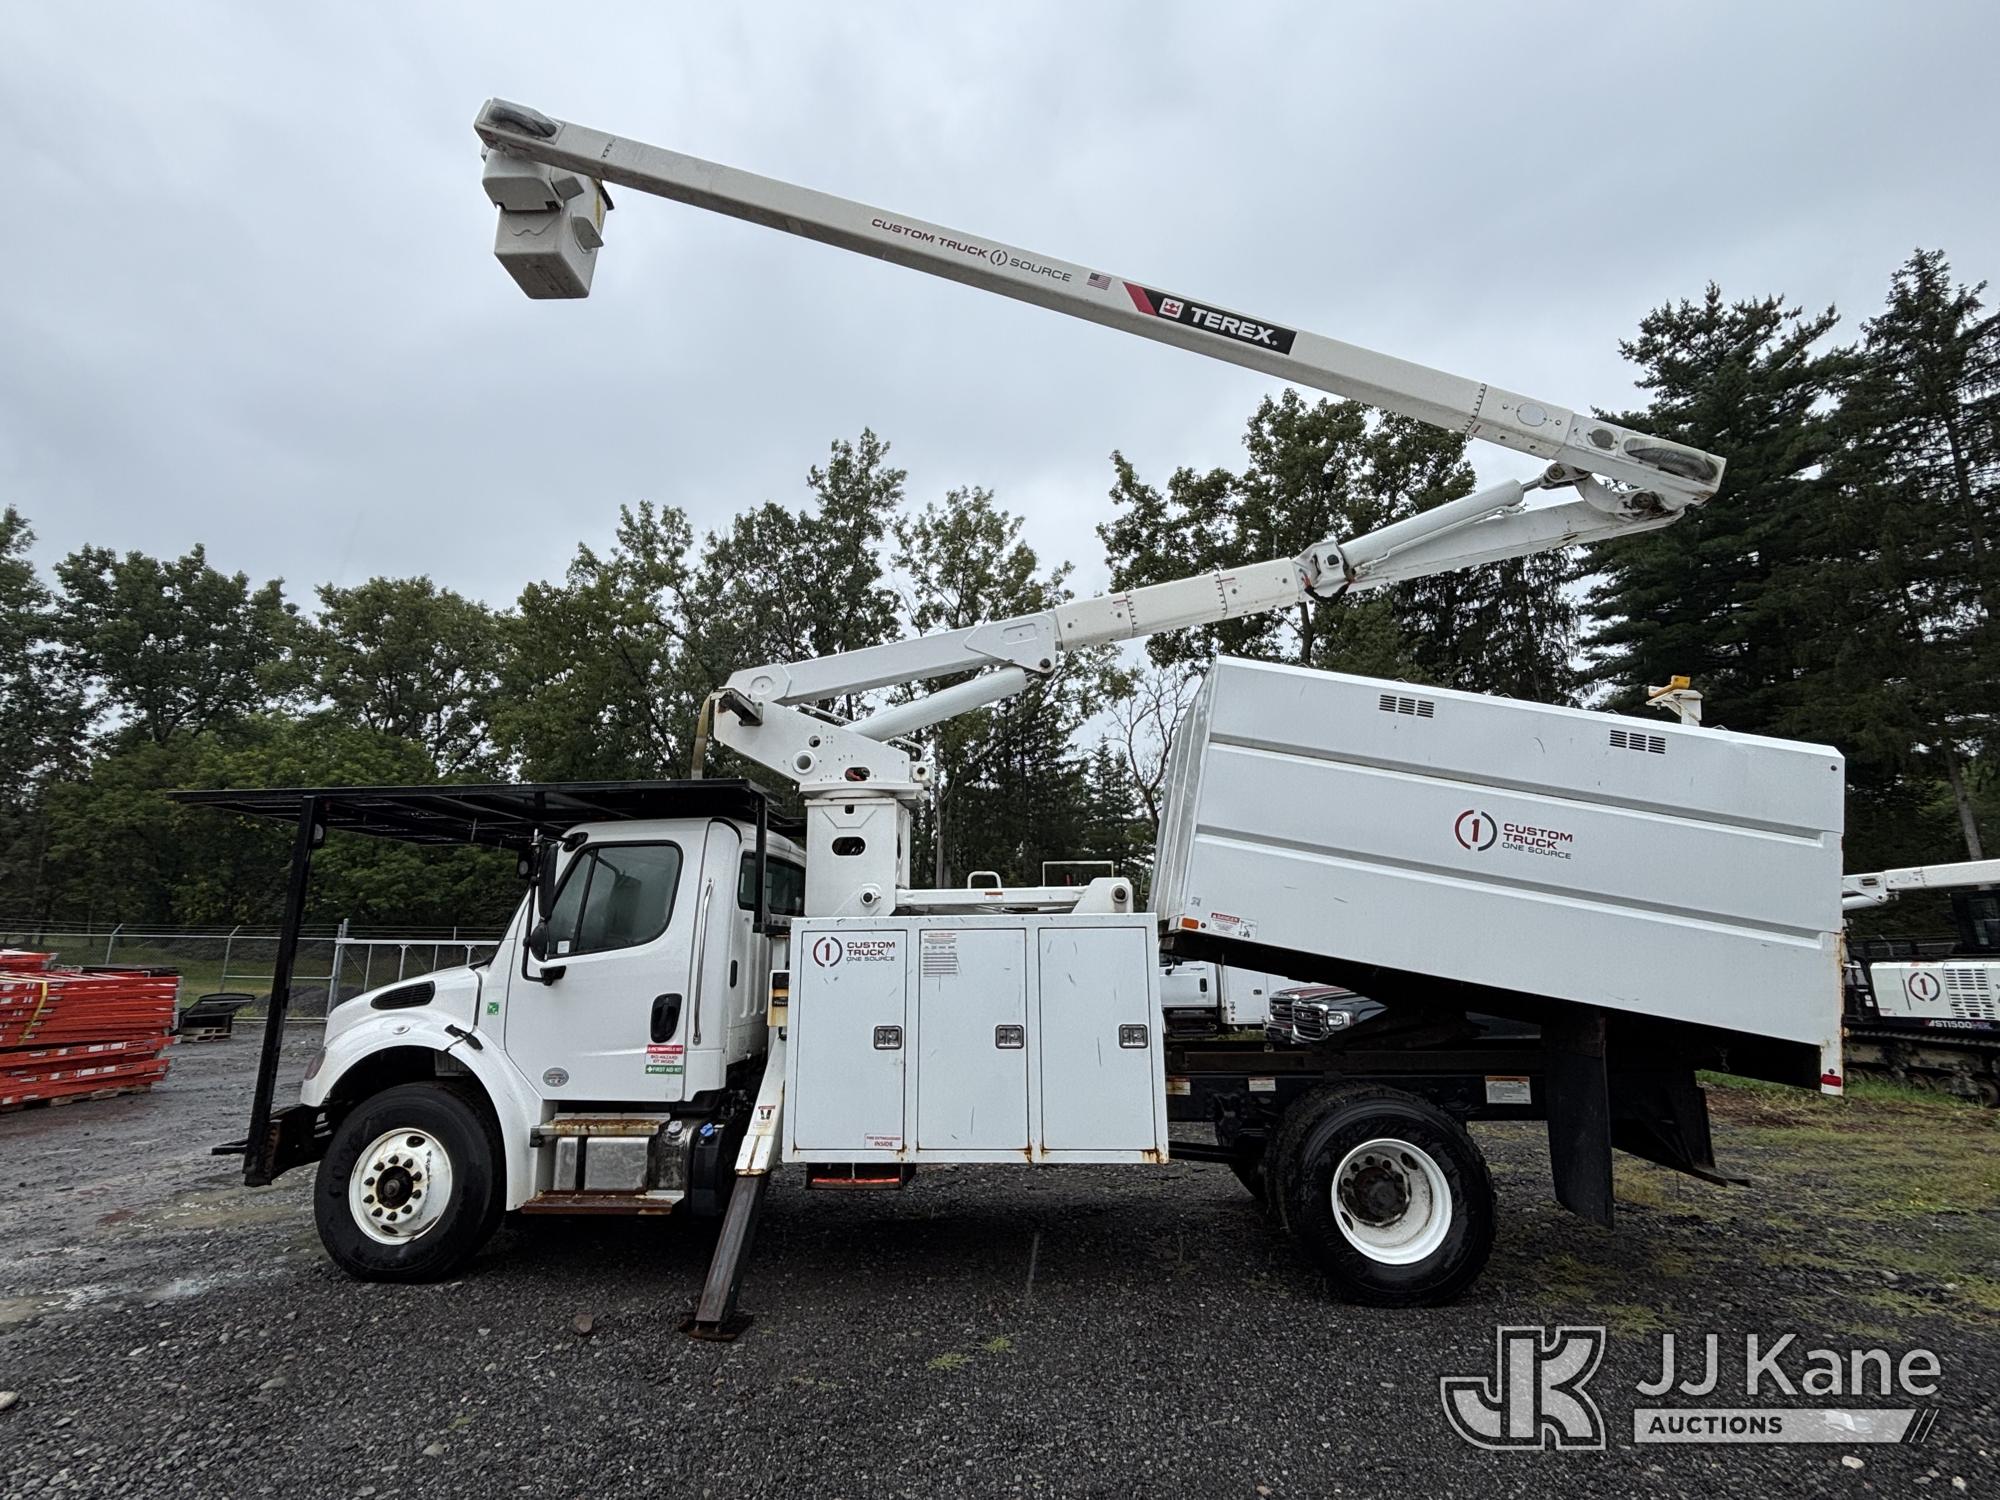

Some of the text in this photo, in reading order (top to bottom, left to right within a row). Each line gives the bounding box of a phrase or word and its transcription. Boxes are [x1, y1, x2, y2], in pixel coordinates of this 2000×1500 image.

[871, 218, 935, 243] CUSTOM
[939, 237, 988, 259] TRUCK
[1009, 258, 1073, 282] SOURCE
[1503, 823, 1573, 843] CUSTOM
[1503, 832, 1558, 850] TRUCK
[1502, 842, 1572, 860] ONE SOURCE
[847, 941, 896, 949] CUSTOM
